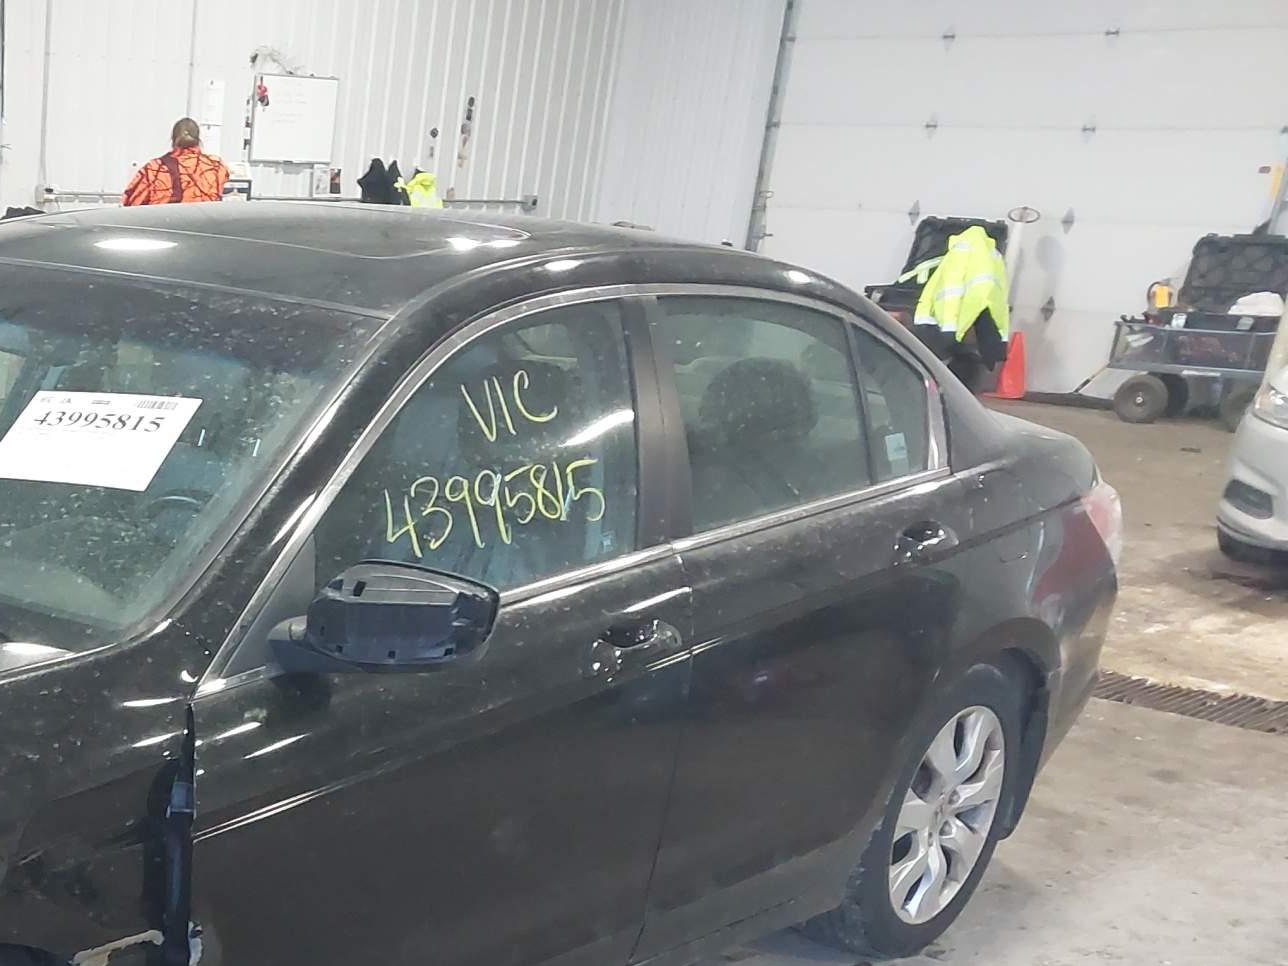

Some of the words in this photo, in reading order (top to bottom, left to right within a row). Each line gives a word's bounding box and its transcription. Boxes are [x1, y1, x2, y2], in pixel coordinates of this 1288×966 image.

[33, 410, 166, 433] 43995815
[461, 370, 558, 442] VIC
[385, 459, 606, 558] 43995815
